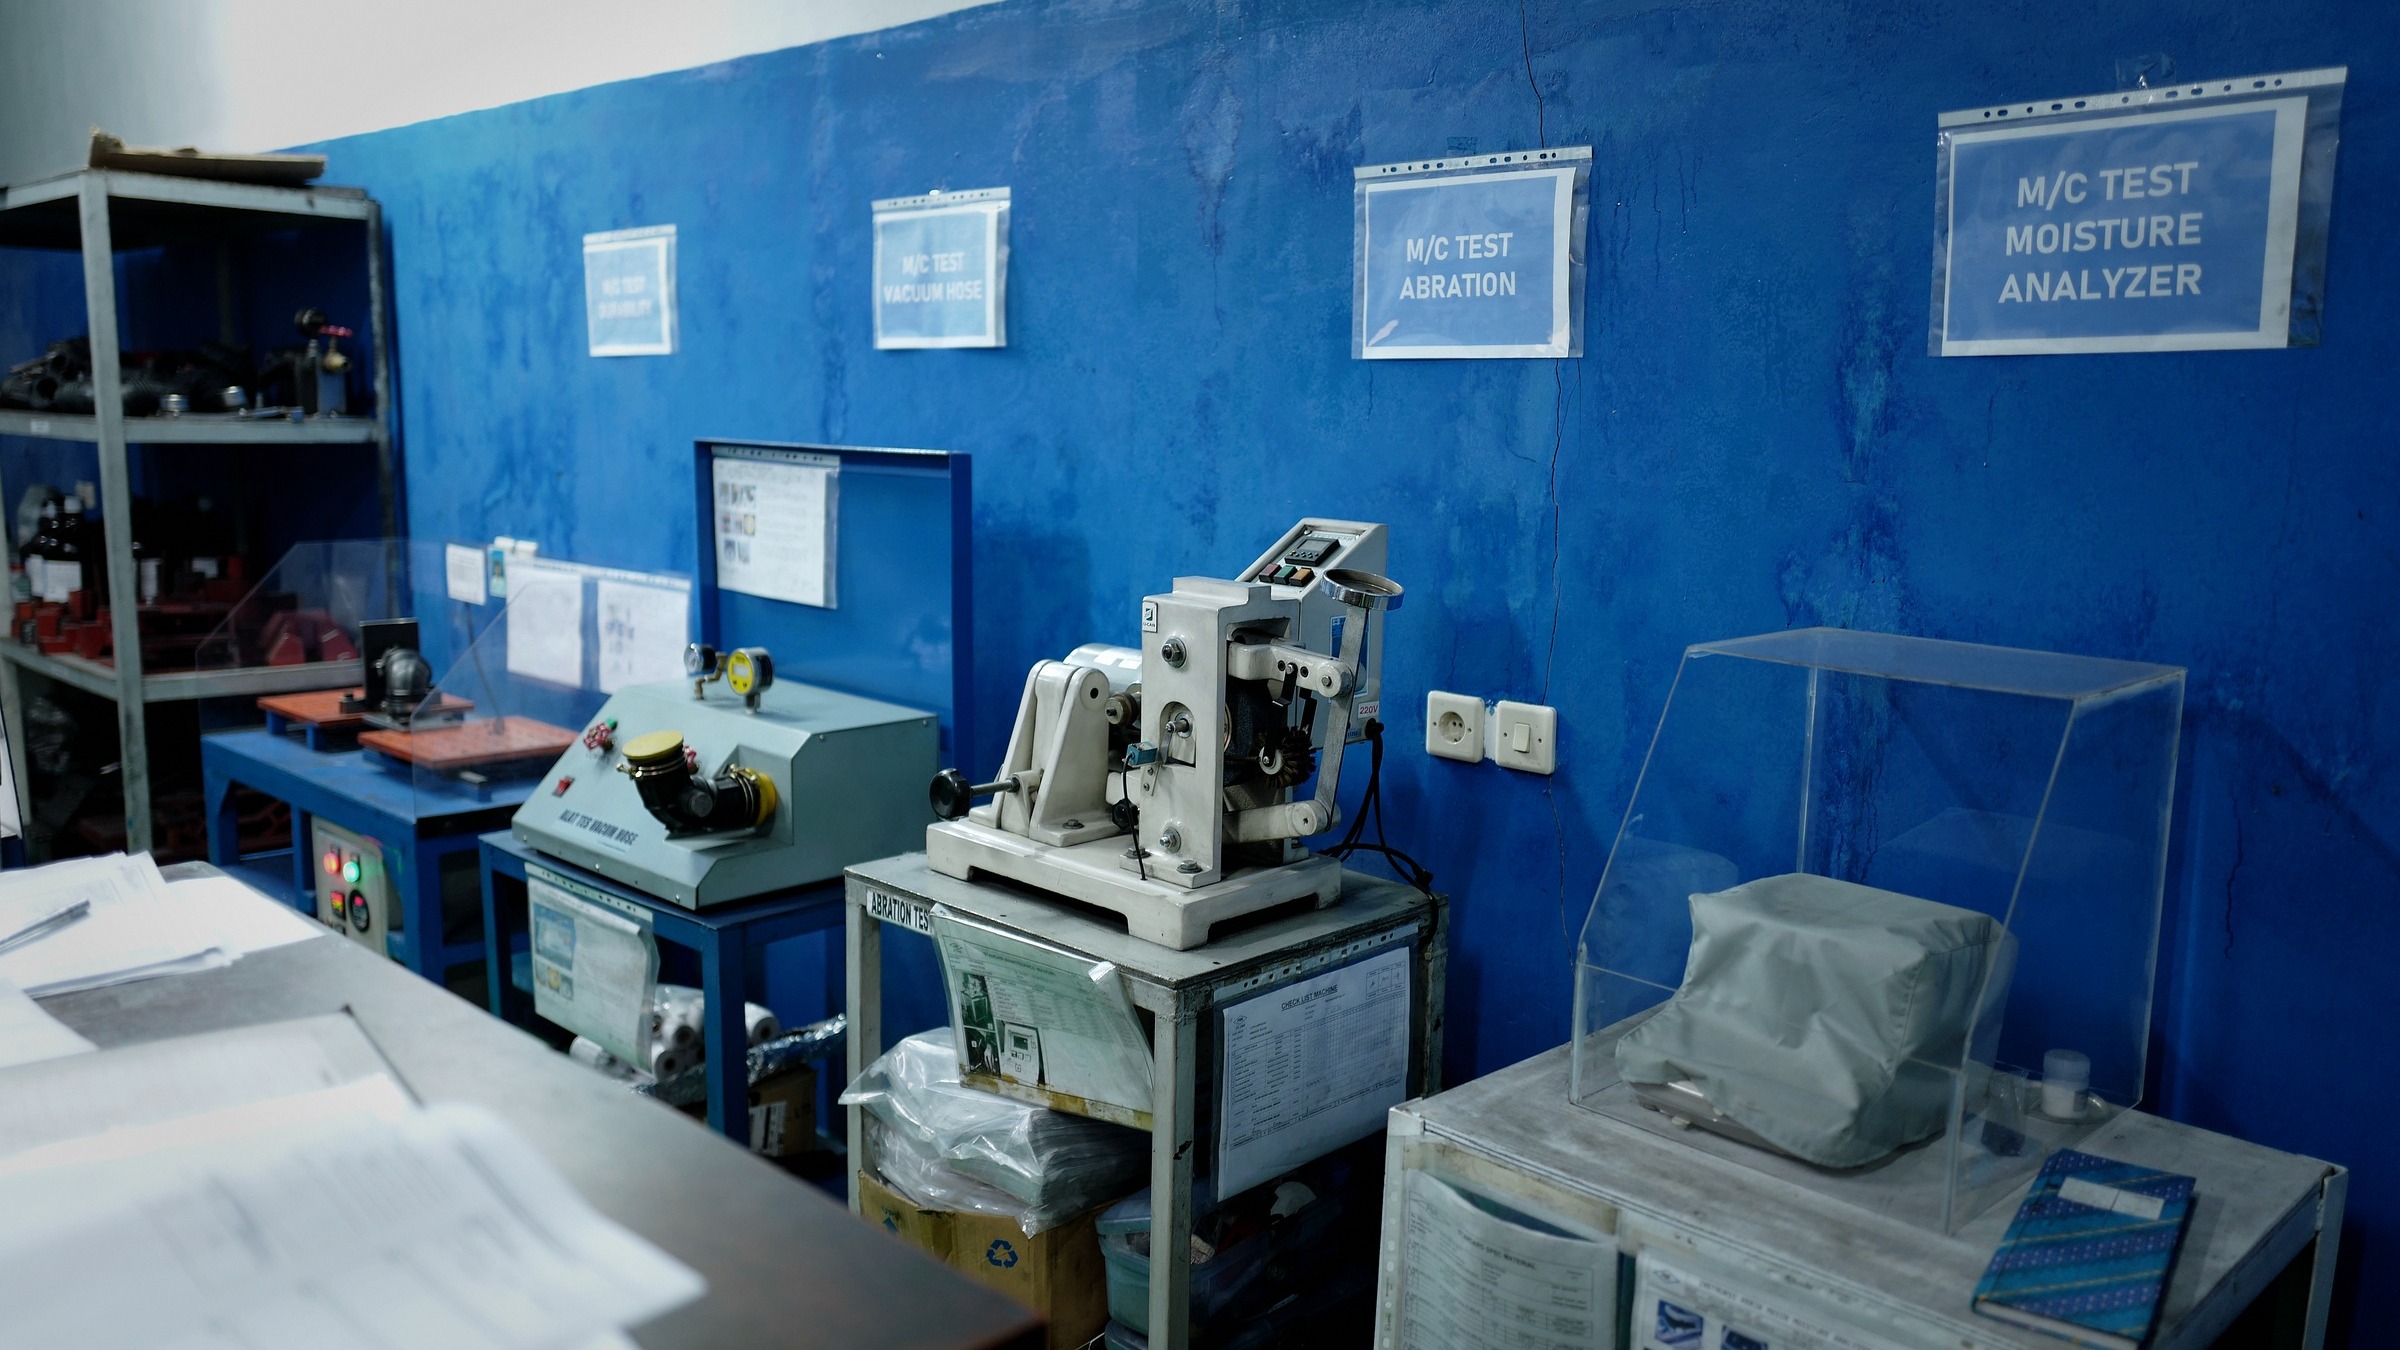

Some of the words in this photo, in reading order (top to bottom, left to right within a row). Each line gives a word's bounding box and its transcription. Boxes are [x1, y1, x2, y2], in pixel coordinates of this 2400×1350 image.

[2017, 171, 2087, 211] M/C
[2099, 161, 2199, 201] TEST
[1406, 234, 1449, 265] M/C
[1455, 232, 1513, 260] TEST
[2005, 212, 2203, 257] MOISTURE
[902, 254, 930, 278] M/C
[931, 251, 966, 274] TEST
[883, 283, 944, 304] VACUUM
[945, 279, 983, 302] HOSE
[1399, 271, 1517, 300] ABRATION
[1998, 263, 2202, 304] ANALYZER
[1359, 703, 1379, 715] 220V
[871, 891, 912, 926] ABRATION
[913, 904, 930, 932] TES
[1281, 998, 1301, 1011] CHECK
[1301, 992, 1314, 1005] LIST
[1313, 984, 1338, 999] MACHINE
